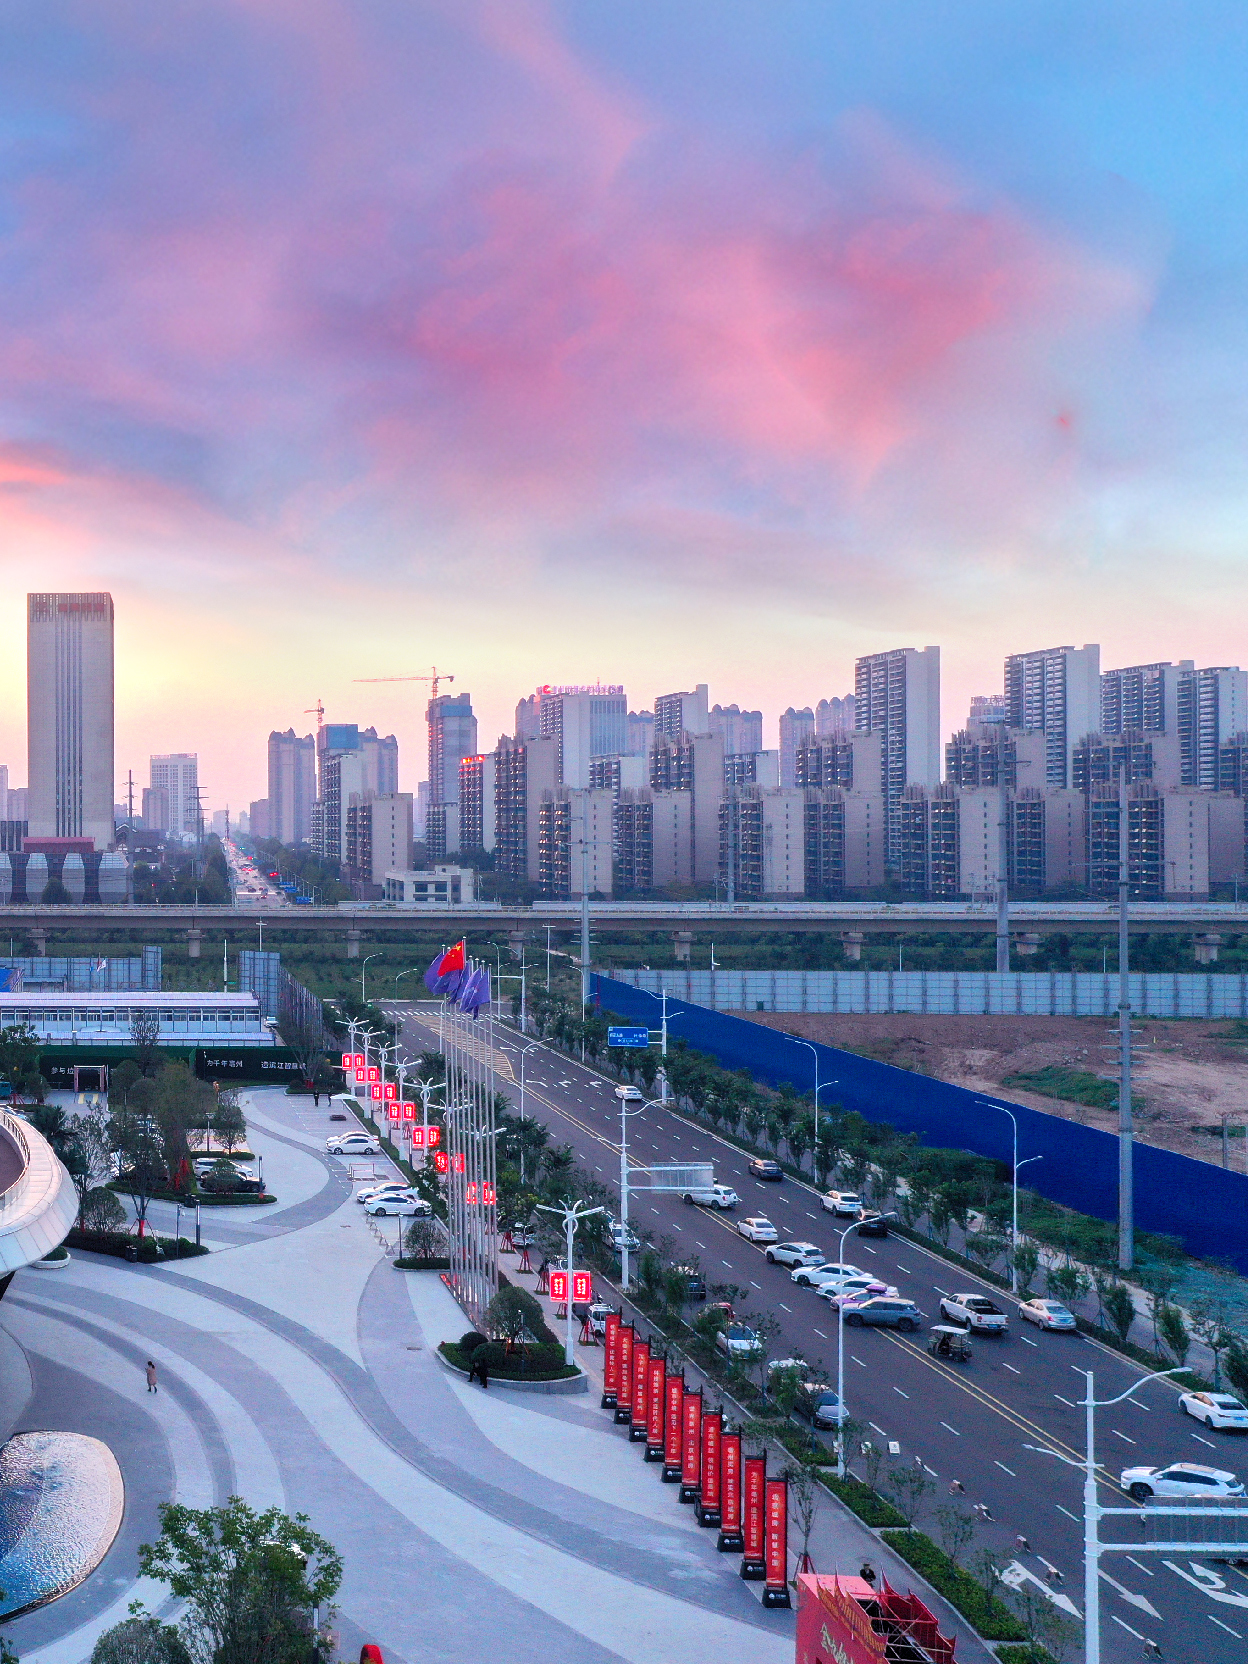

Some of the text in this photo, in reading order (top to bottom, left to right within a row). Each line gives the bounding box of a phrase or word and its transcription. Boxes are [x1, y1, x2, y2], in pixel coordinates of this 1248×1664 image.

[207, 1060, 243, 1068] 为千年亳州
